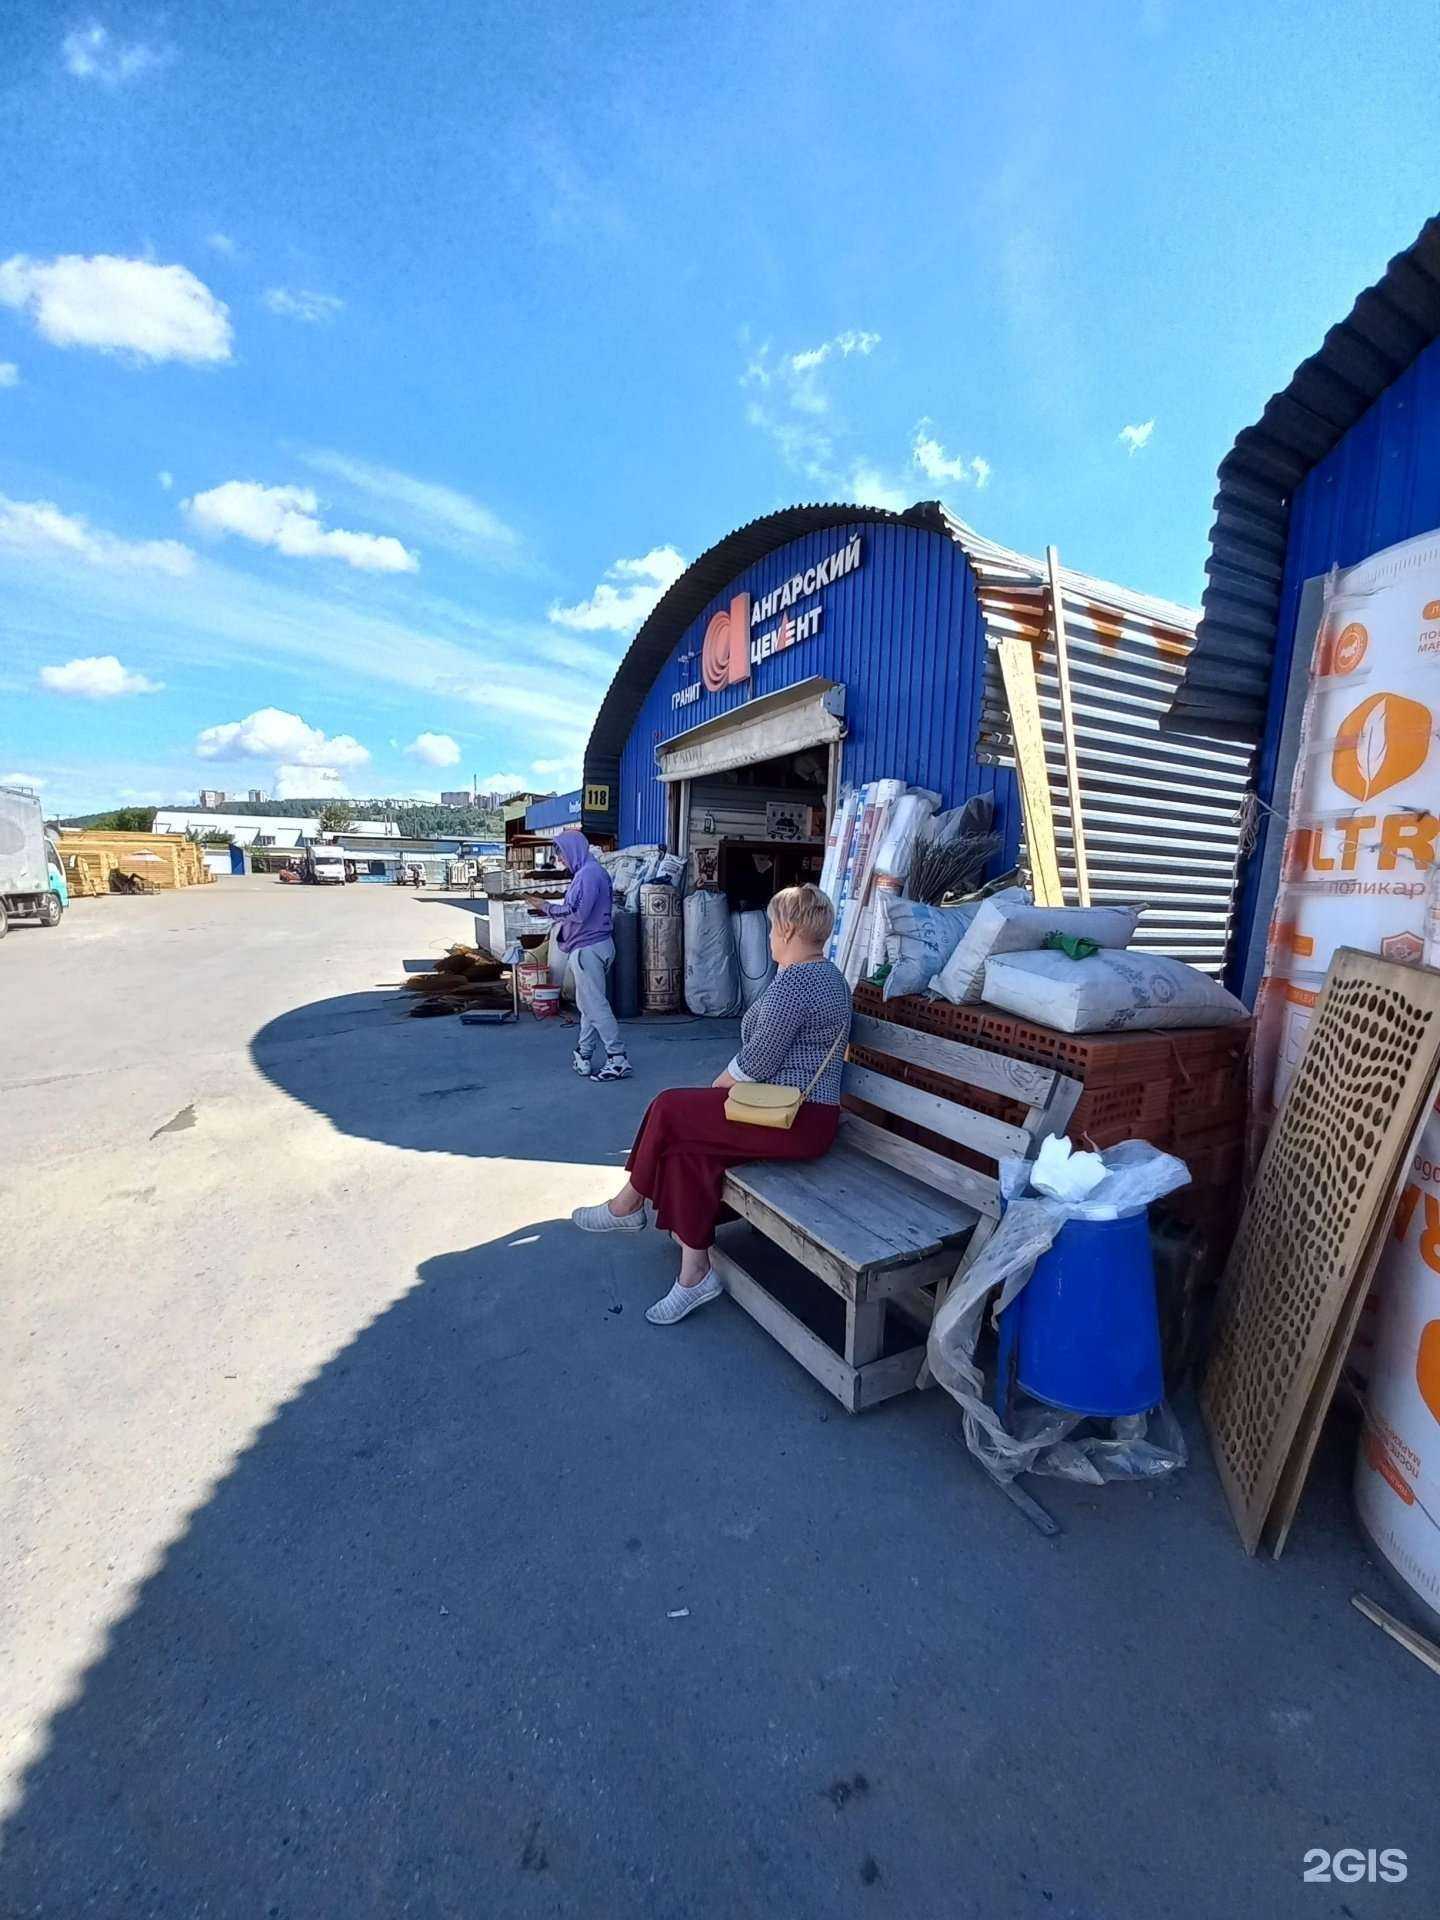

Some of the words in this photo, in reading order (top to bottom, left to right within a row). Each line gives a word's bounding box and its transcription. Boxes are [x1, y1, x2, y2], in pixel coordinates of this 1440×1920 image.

[750, 533, 862, 627] АНГАРСКИЙ
[751, 605, 823, 665] ЦЕМЕНТ
[672, 682, 701, 711] ГРАНИТ
[588, 790, 607, 805] 118
